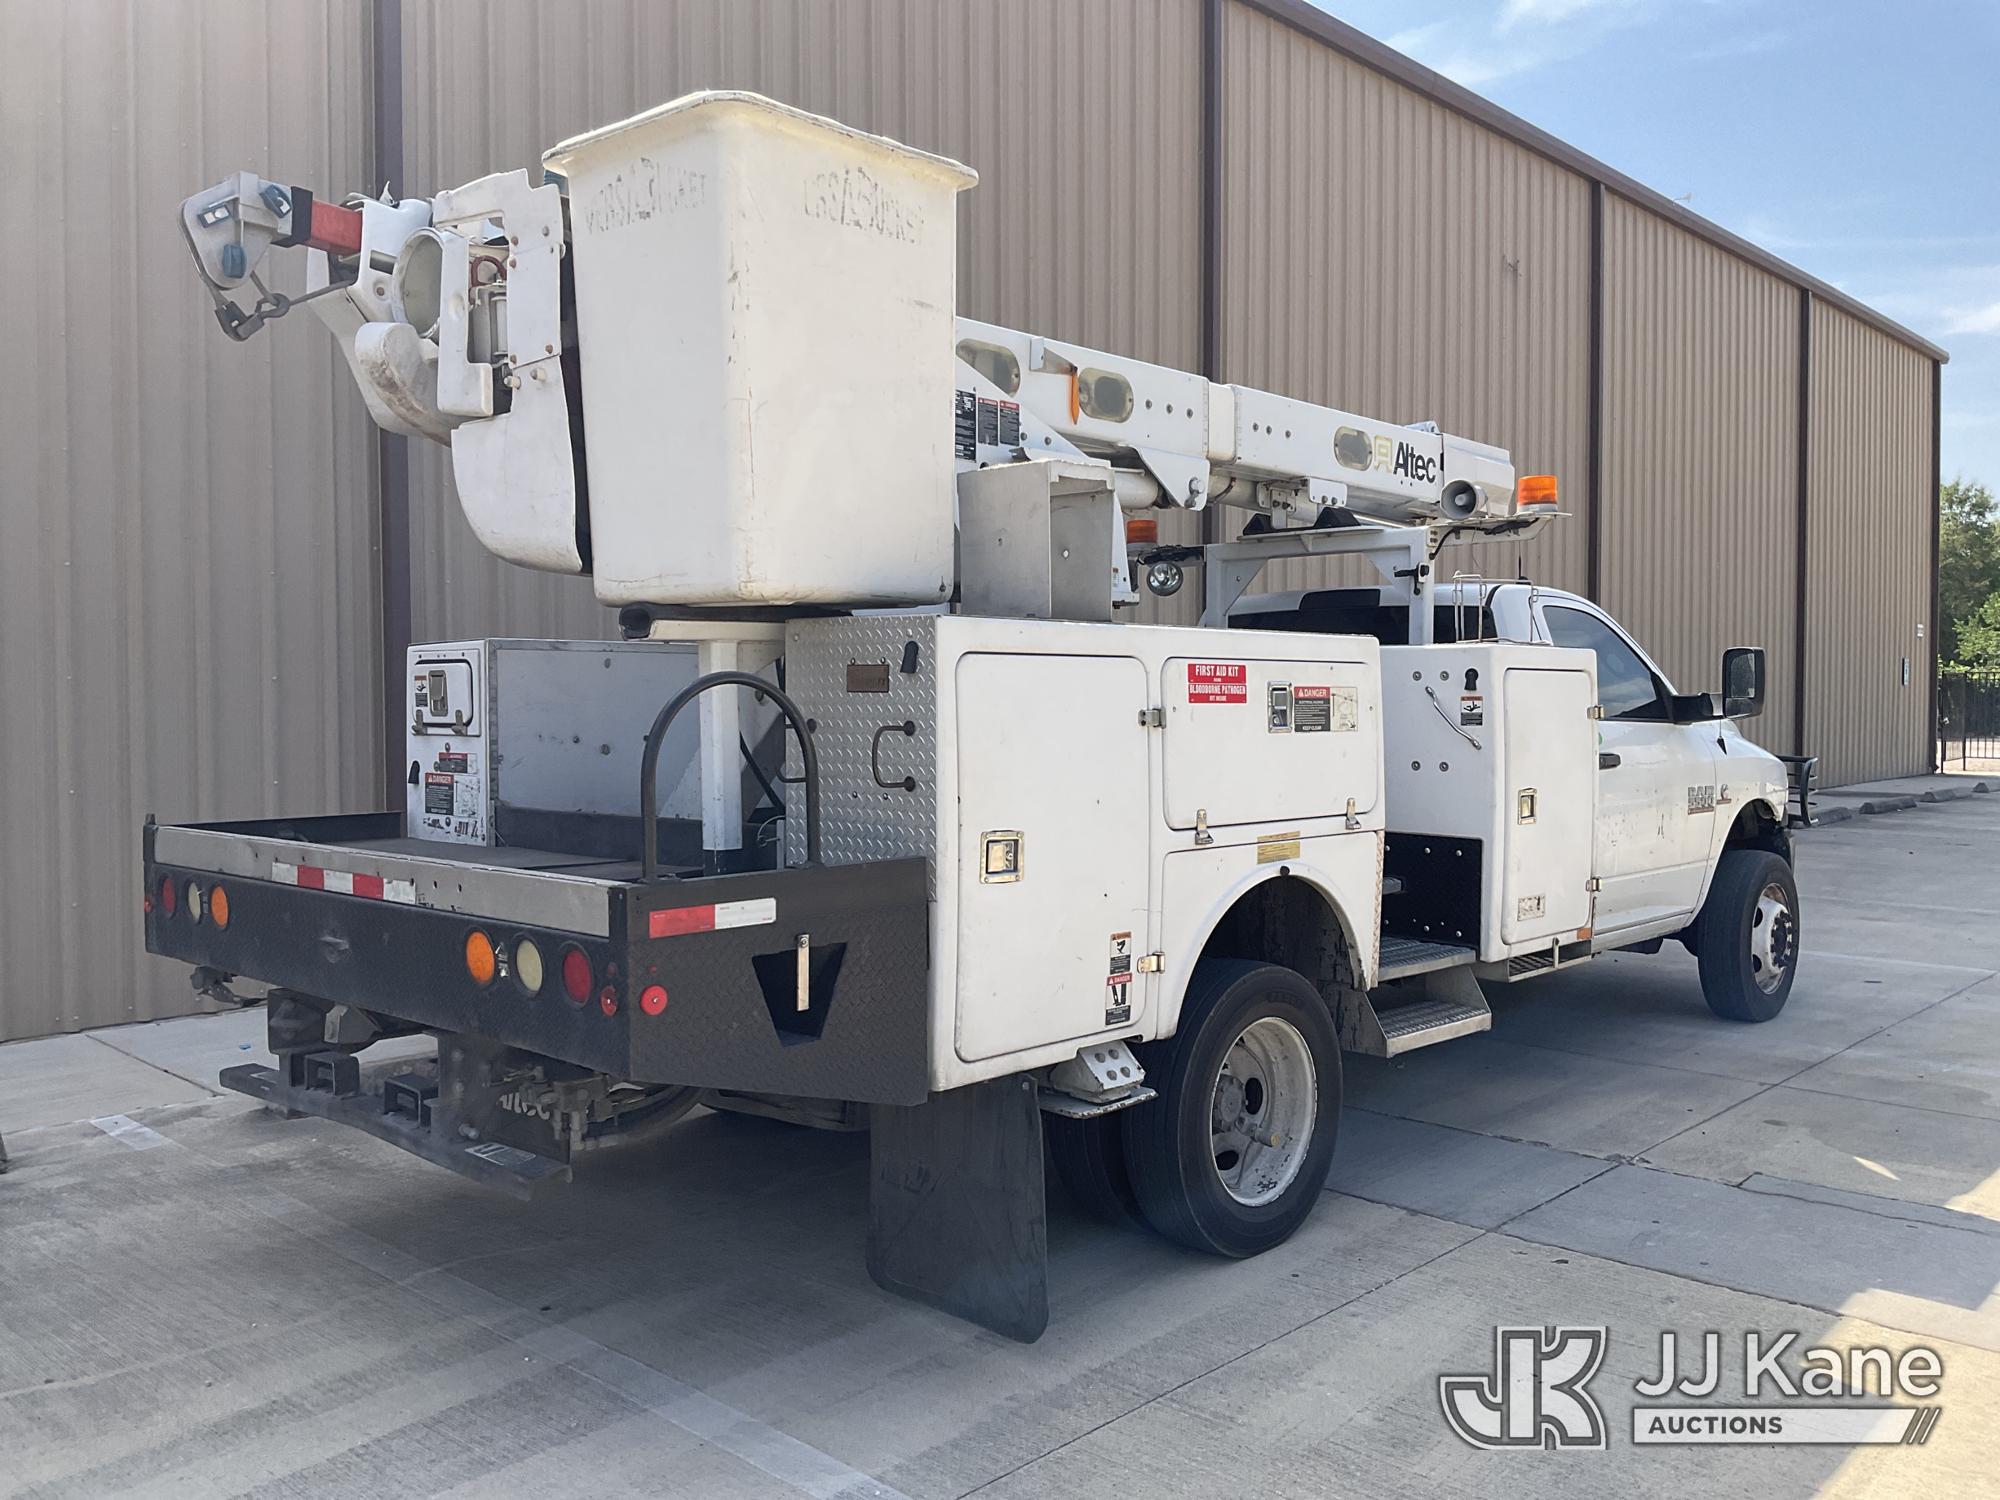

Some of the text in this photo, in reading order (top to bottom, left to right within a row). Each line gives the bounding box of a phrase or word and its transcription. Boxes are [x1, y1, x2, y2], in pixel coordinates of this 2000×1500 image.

[1393, 441, 1436, 483] Altec
[1195, 664, 1239, 677] FIRST AID KIT
[1189, 684, 1246, 695] BLOODBORNE PATHOGEN
[1304, 688, 1327, 698] DANGER
[432, 775, 452, 784] DANGER
[1688, 785, 1714, 797] RAM
[1114, 975, 1131, 983] DANGER
